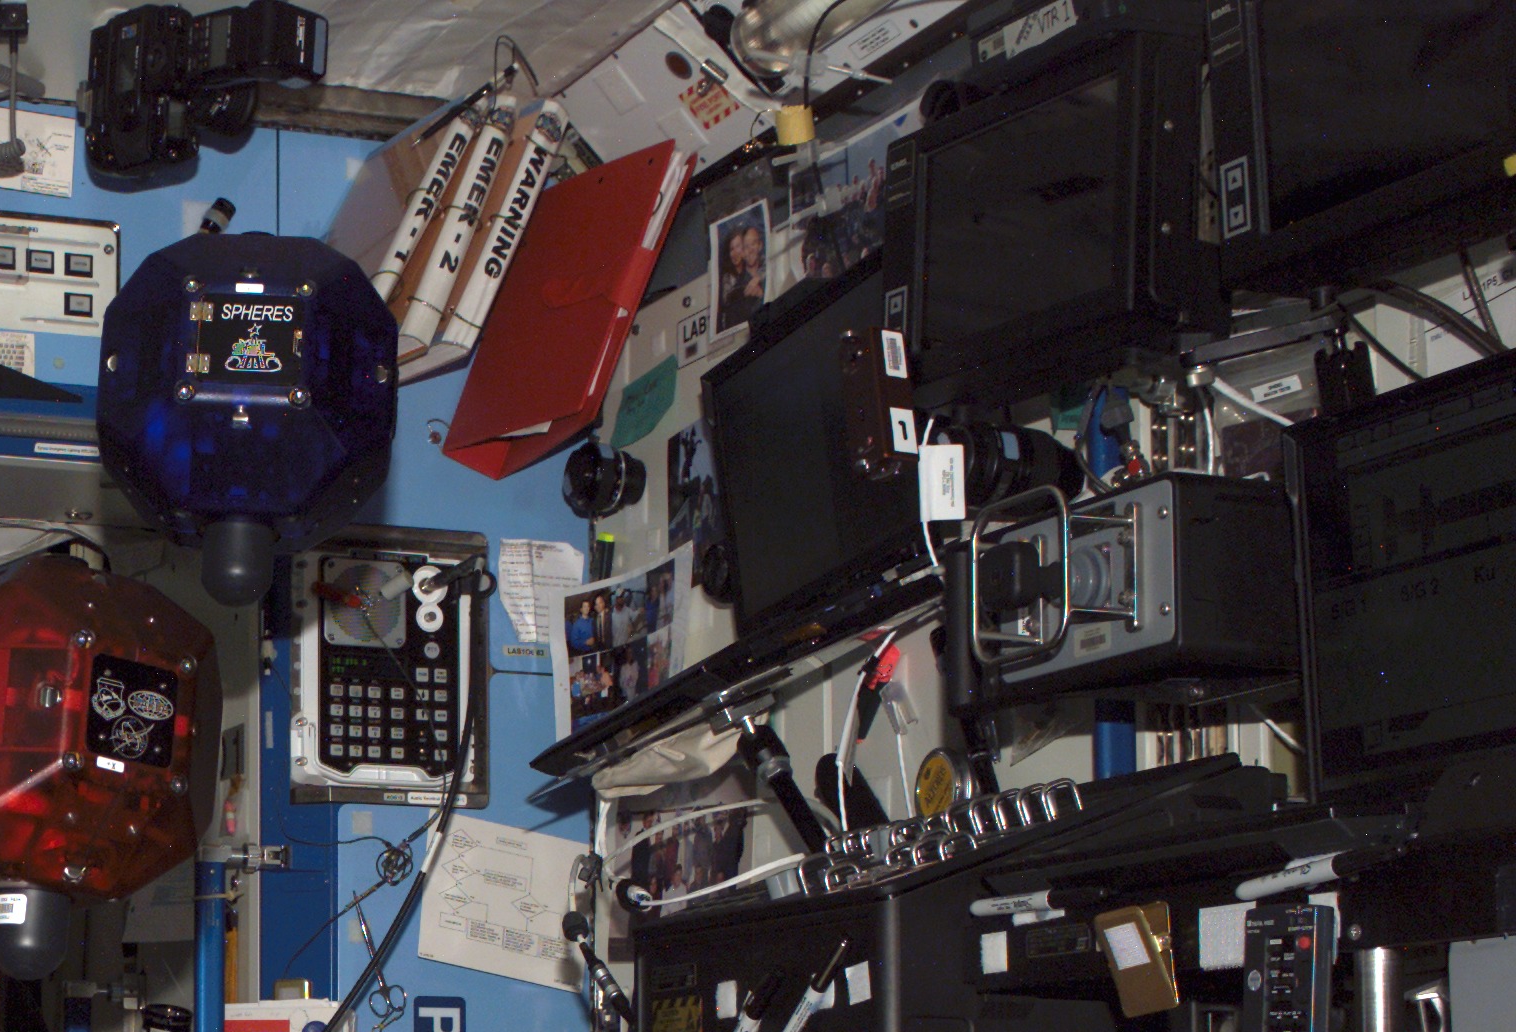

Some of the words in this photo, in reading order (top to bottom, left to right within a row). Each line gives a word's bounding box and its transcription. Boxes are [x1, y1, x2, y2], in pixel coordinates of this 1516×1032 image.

[1037, 7, 1061, 34] VTR
[415, 132, 468, 222] EMER
[458, 136, 505, 227] EMER
[484, 147, 547, 279] WARNING
[439, 250, 459, 274] 2
[221, 303, 294, 322] SPHERES
